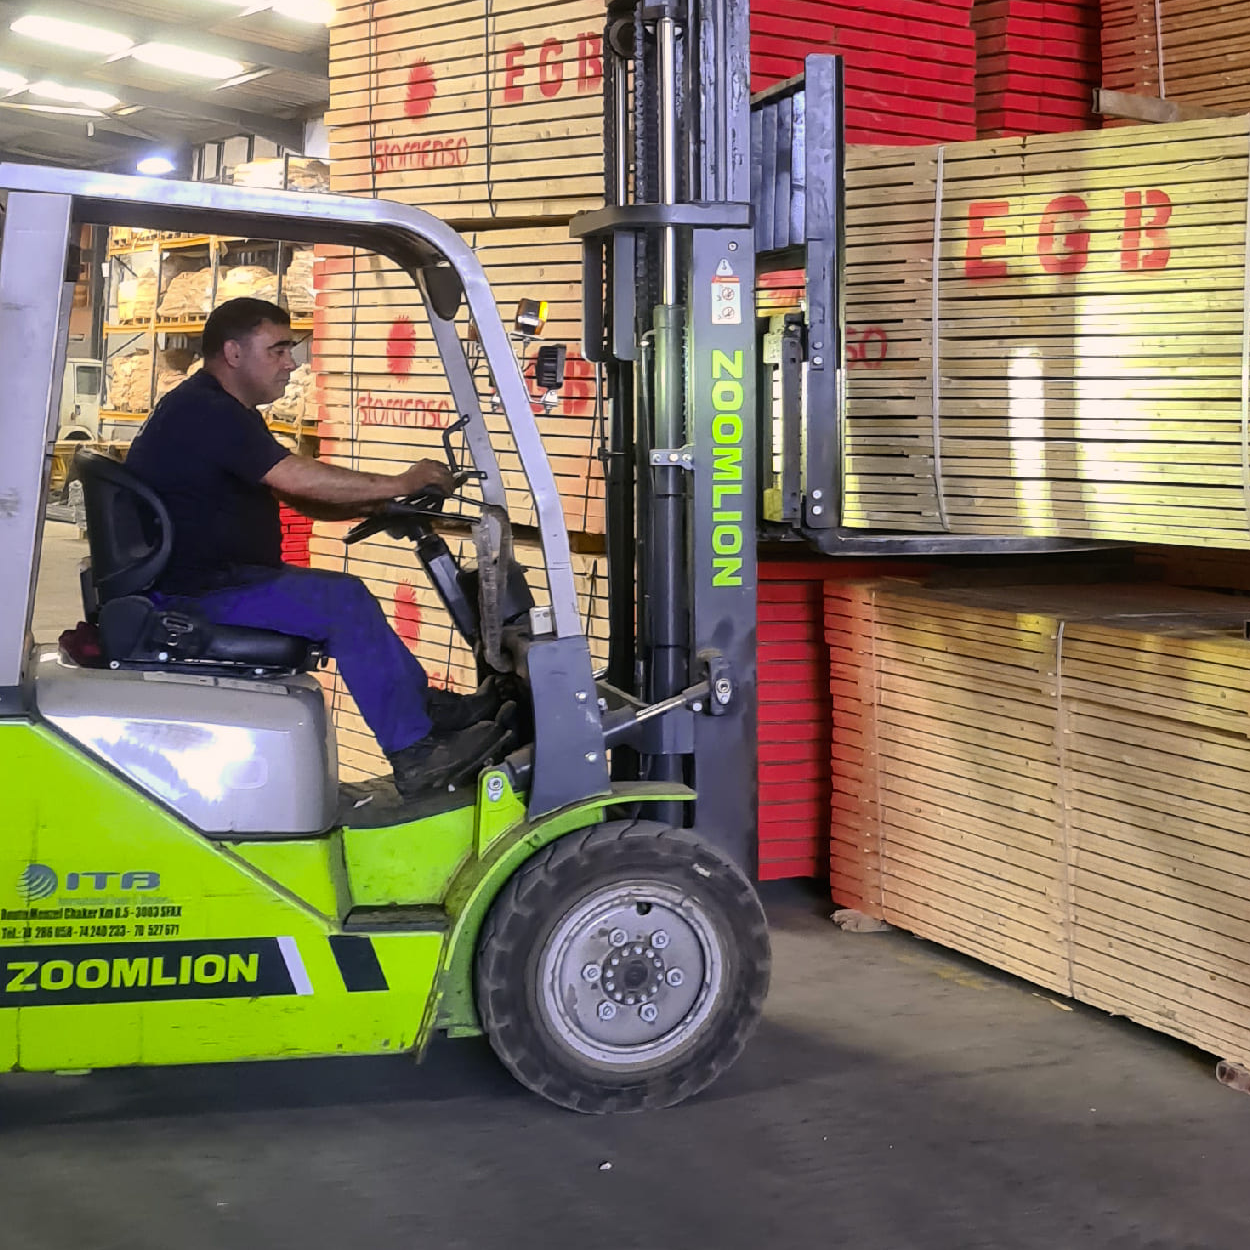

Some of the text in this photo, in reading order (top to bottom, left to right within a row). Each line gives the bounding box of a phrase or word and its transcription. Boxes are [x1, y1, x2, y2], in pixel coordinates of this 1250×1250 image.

[505, 32, 603, 102] EGB
[965, 190, 1172, 282] EGB
[358, 390, 450, 429] storaenso
[712, 349, 744, 586] ZOOMLION
[6, 953, 259, 993] ZOOMLION
